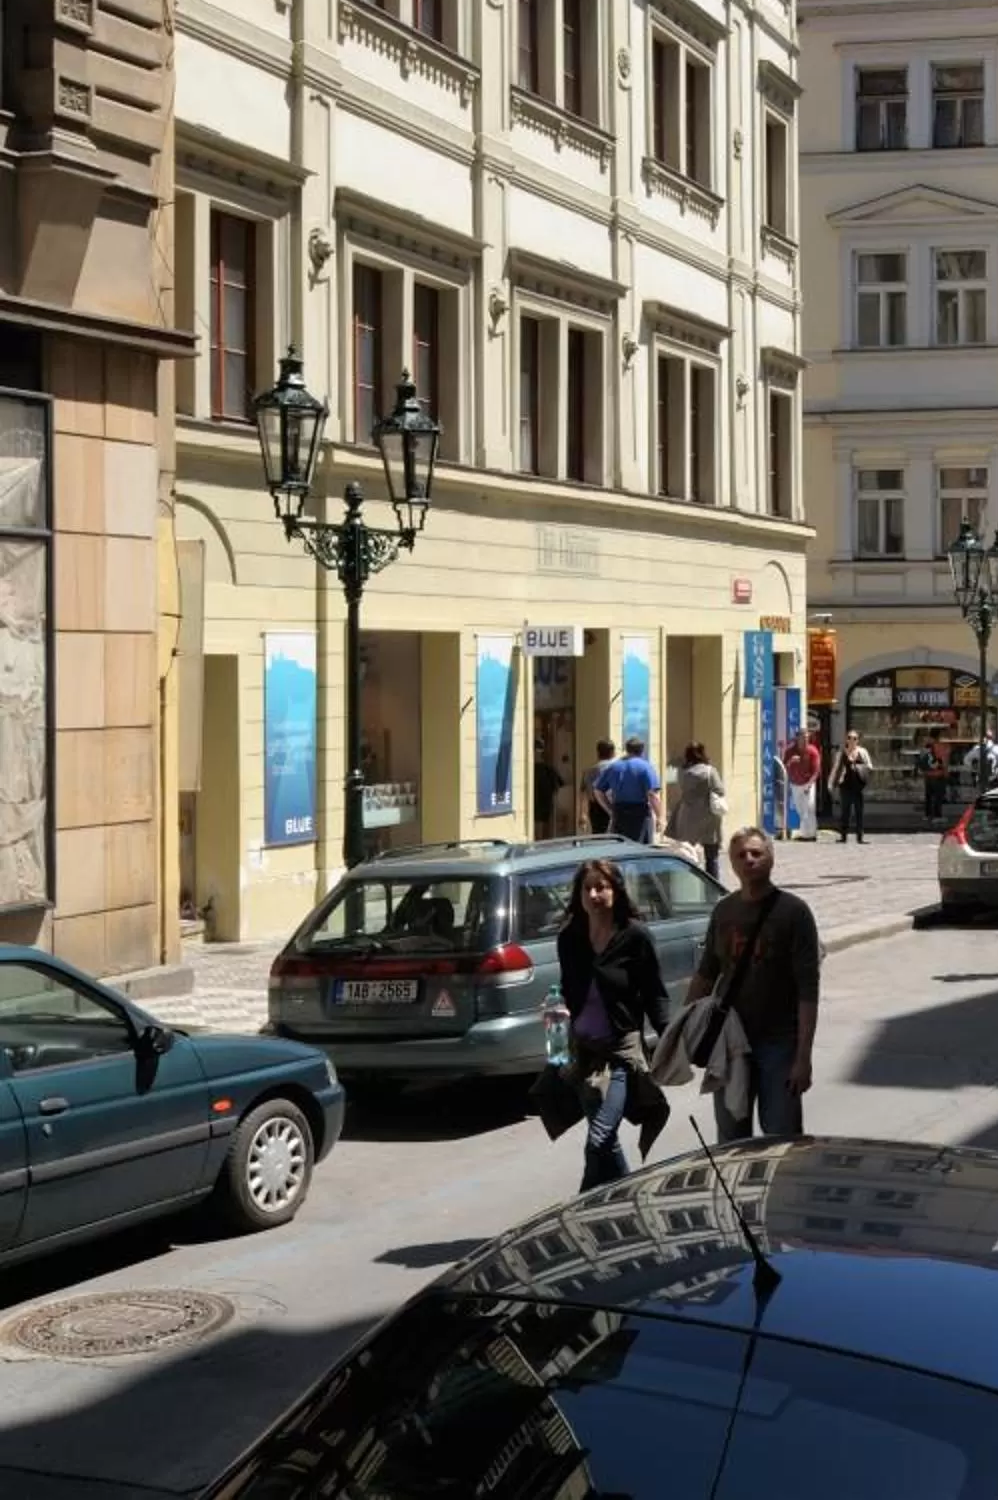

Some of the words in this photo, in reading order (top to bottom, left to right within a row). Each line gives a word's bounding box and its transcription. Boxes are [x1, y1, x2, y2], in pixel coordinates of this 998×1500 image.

[526, 630, 569, 648] BLUE
[762, 709, 774, 815] CHANGE
[285, 815, 313, 835] BLUE
